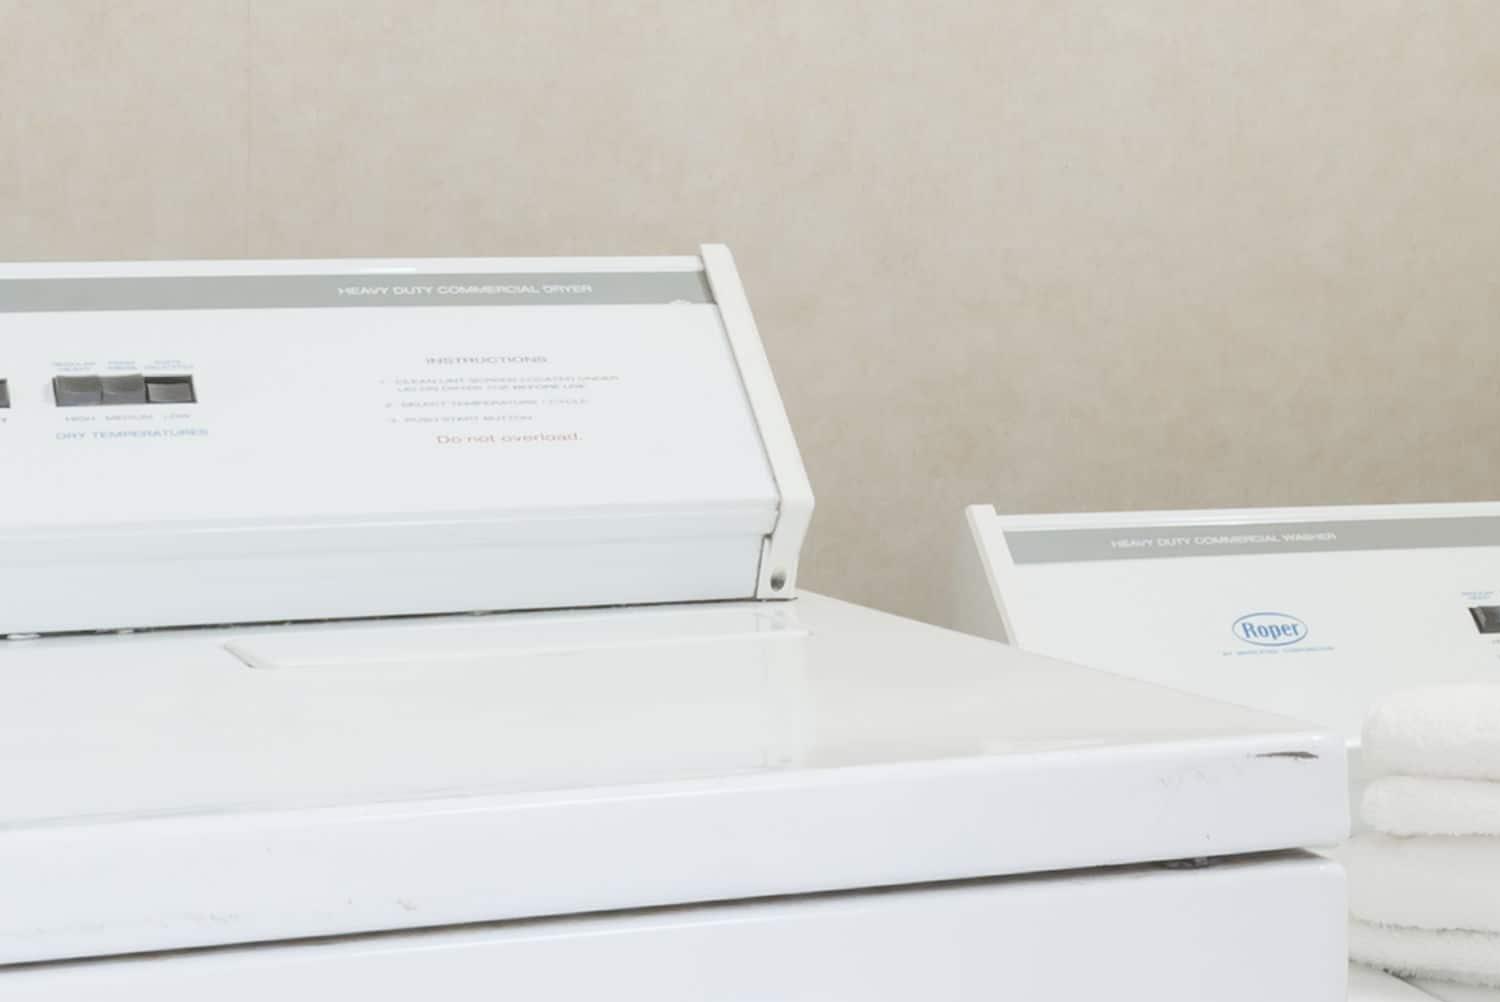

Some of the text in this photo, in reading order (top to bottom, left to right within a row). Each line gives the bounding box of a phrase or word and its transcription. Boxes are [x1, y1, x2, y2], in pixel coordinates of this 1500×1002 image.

[337, 286, 389, 296] HEAVY
[392, 286, 433, 296] DUTY
[437, 285, 541, 295] COMMERCIAL
[436, 434, 462, 444] Do
[466, 434, 496, 443] not
[1110, 538, 1153, 548] HEAVY
[1157, 537, 1190, 547] DUTY
[1240, 622, 1299, 640] Roper
